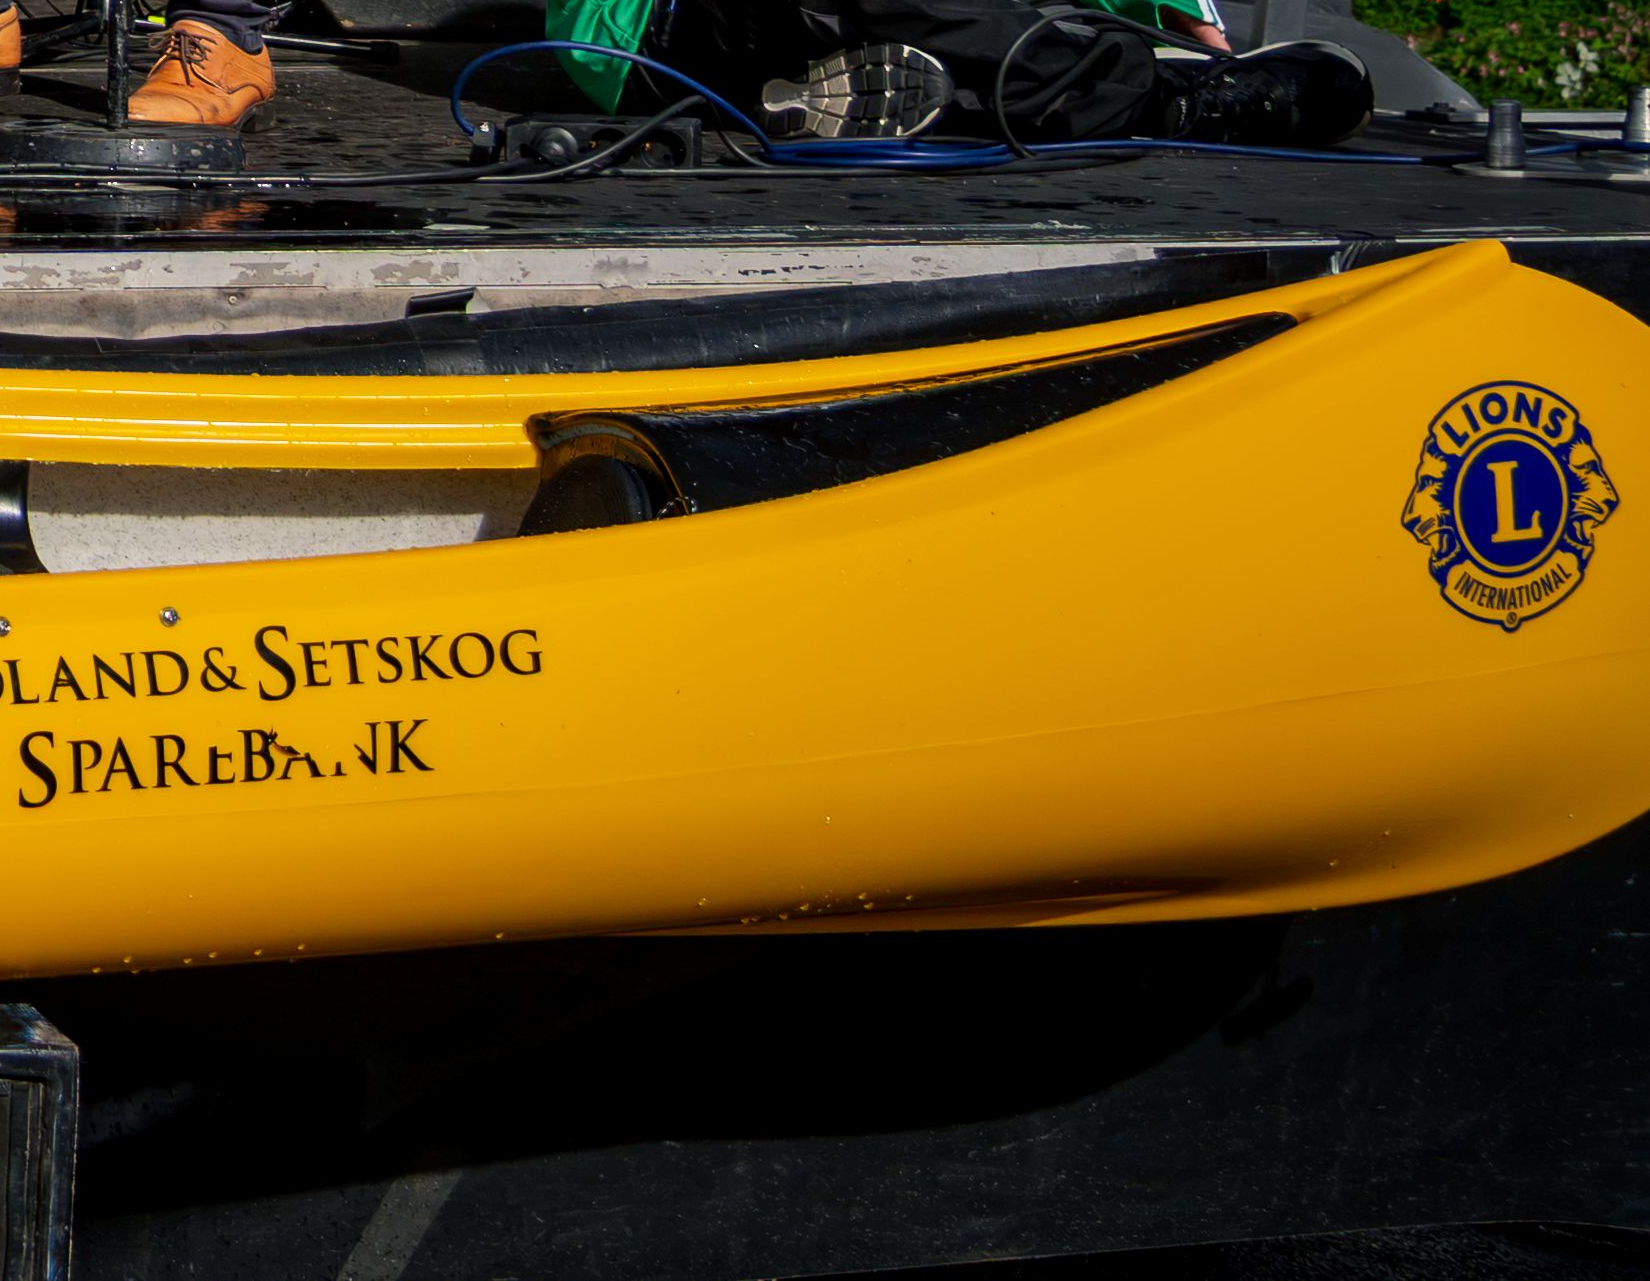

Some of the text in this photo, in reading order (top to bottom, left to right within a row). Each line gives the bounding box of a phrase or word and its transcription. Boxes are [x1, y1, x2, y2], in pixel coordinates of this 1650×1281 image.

[1441, 392, 1568, 449] LIONS
[1487, 460, 1544, 543] L
[1454, 563, 1572, 610] INTERNATIONAL
[254, 625, 543, 702] SETSKOG
